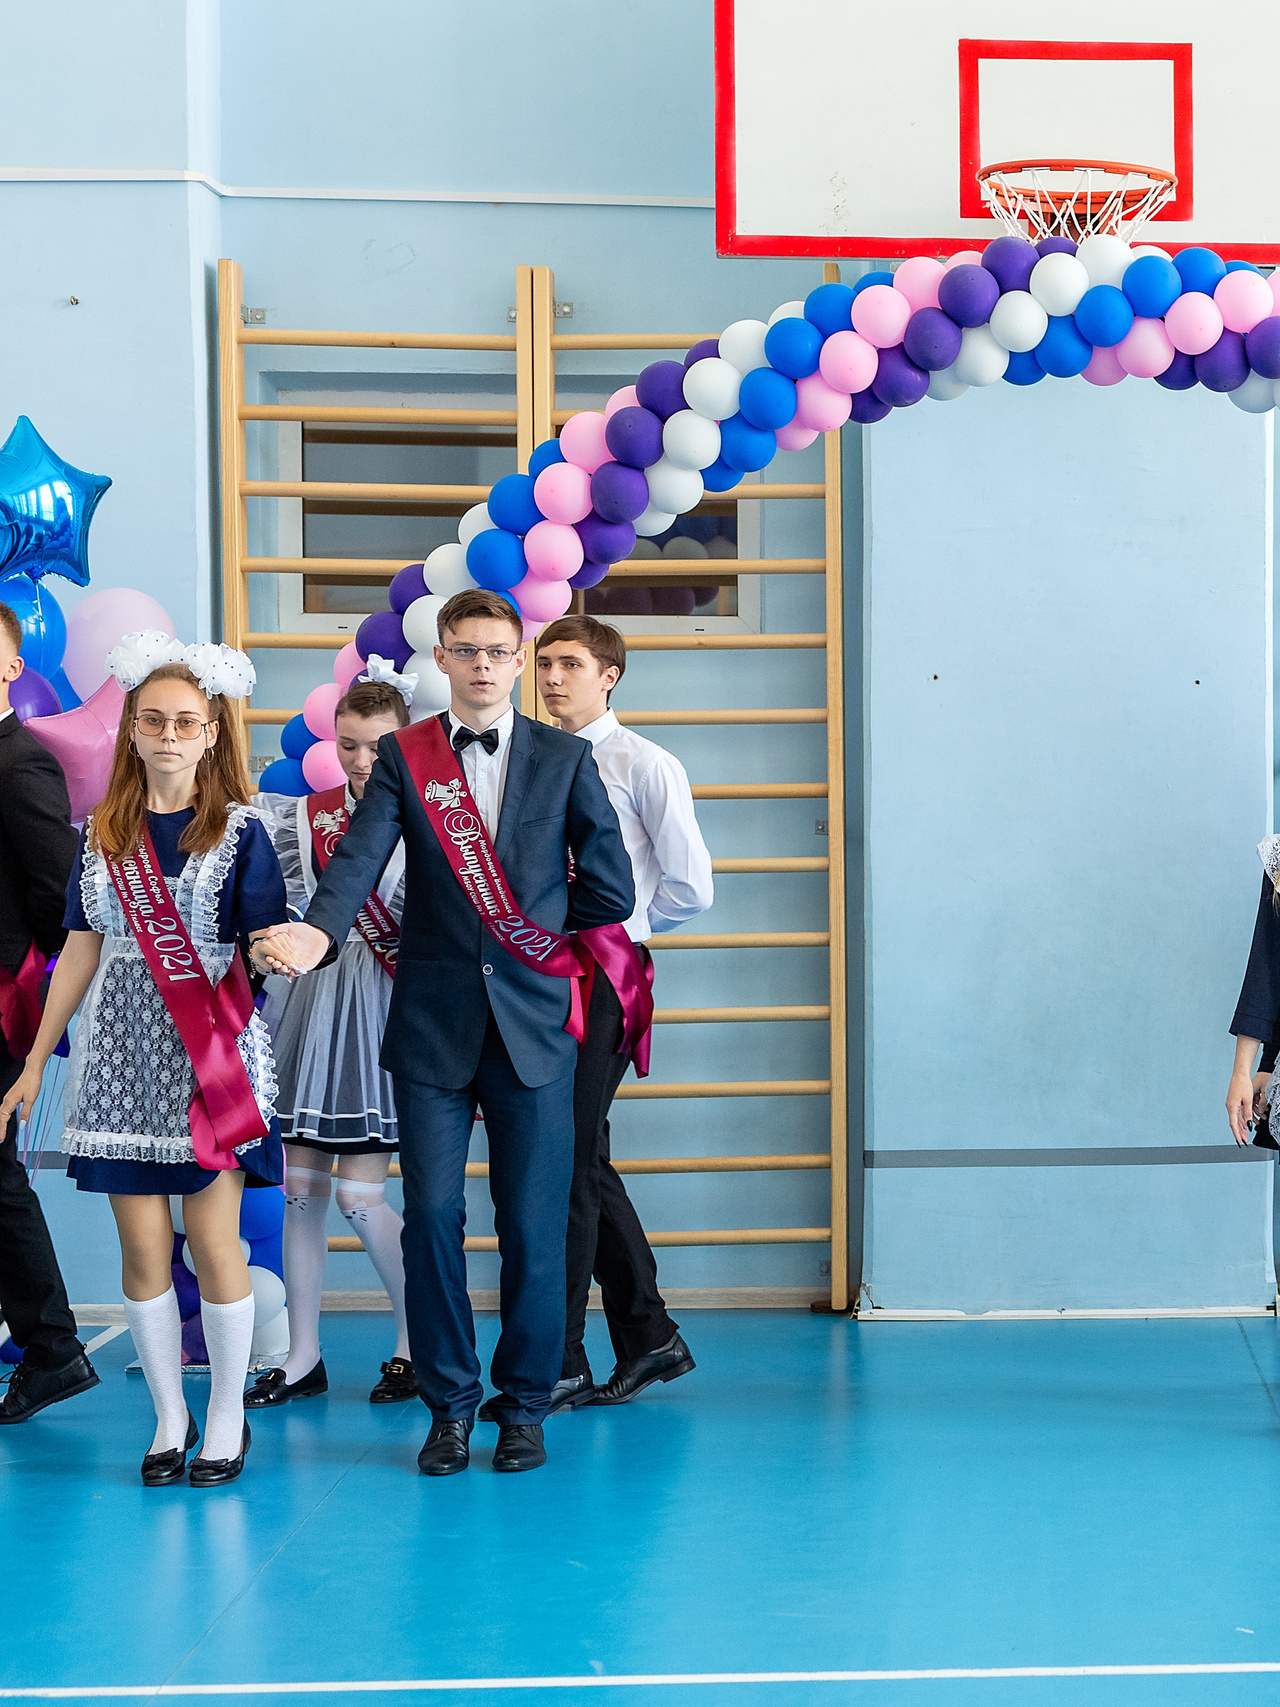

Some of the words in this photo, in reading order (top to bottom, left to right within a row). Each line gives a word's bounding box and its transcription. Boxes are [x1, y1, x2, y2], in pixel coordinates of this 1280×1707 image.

[148, 875, 165, 905] Софья
[444, 808, 501, 917] Выпускник
[494, 915, 560, 962] 2021
[478, 839, 498, 878] Мордовцев
[495, 877, 513, 914] Владислав
[366, 893, 391, 934] настасия
[144, 917, 200, 981] 2021
